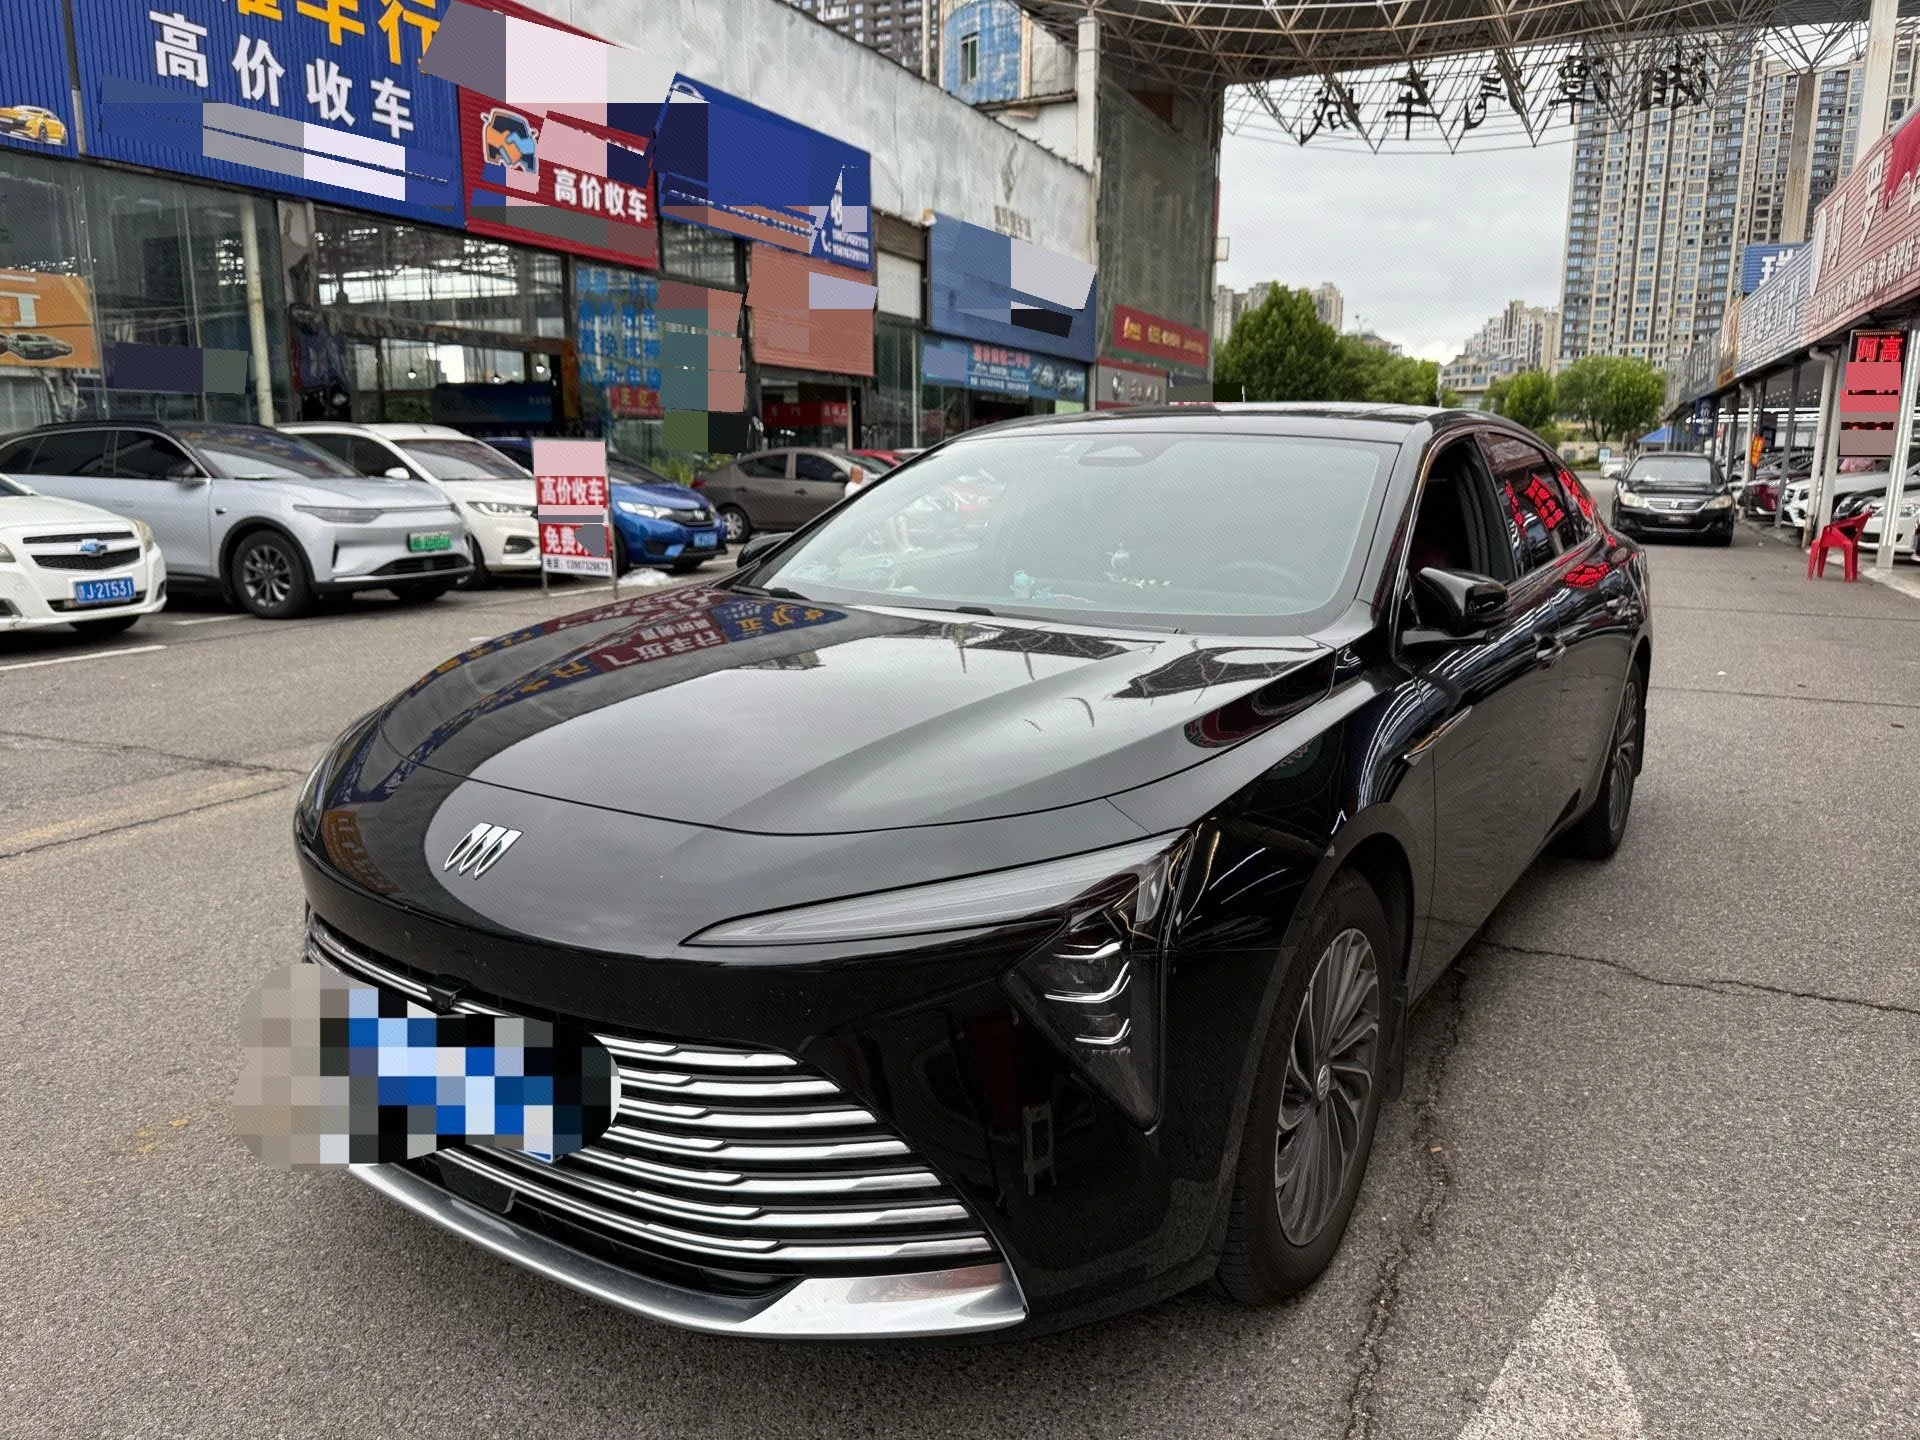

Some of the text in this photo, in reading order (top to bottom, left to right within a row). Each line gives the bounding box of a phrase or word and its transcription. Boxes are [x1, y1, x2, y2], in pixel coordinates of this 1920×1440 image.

[149, 11, 415, 139] 高价收车
[553, 168, 648, 223] 高价收车
[540, 476, 604, 505] 高价收车
[544, 526, 600, 556] 免费
